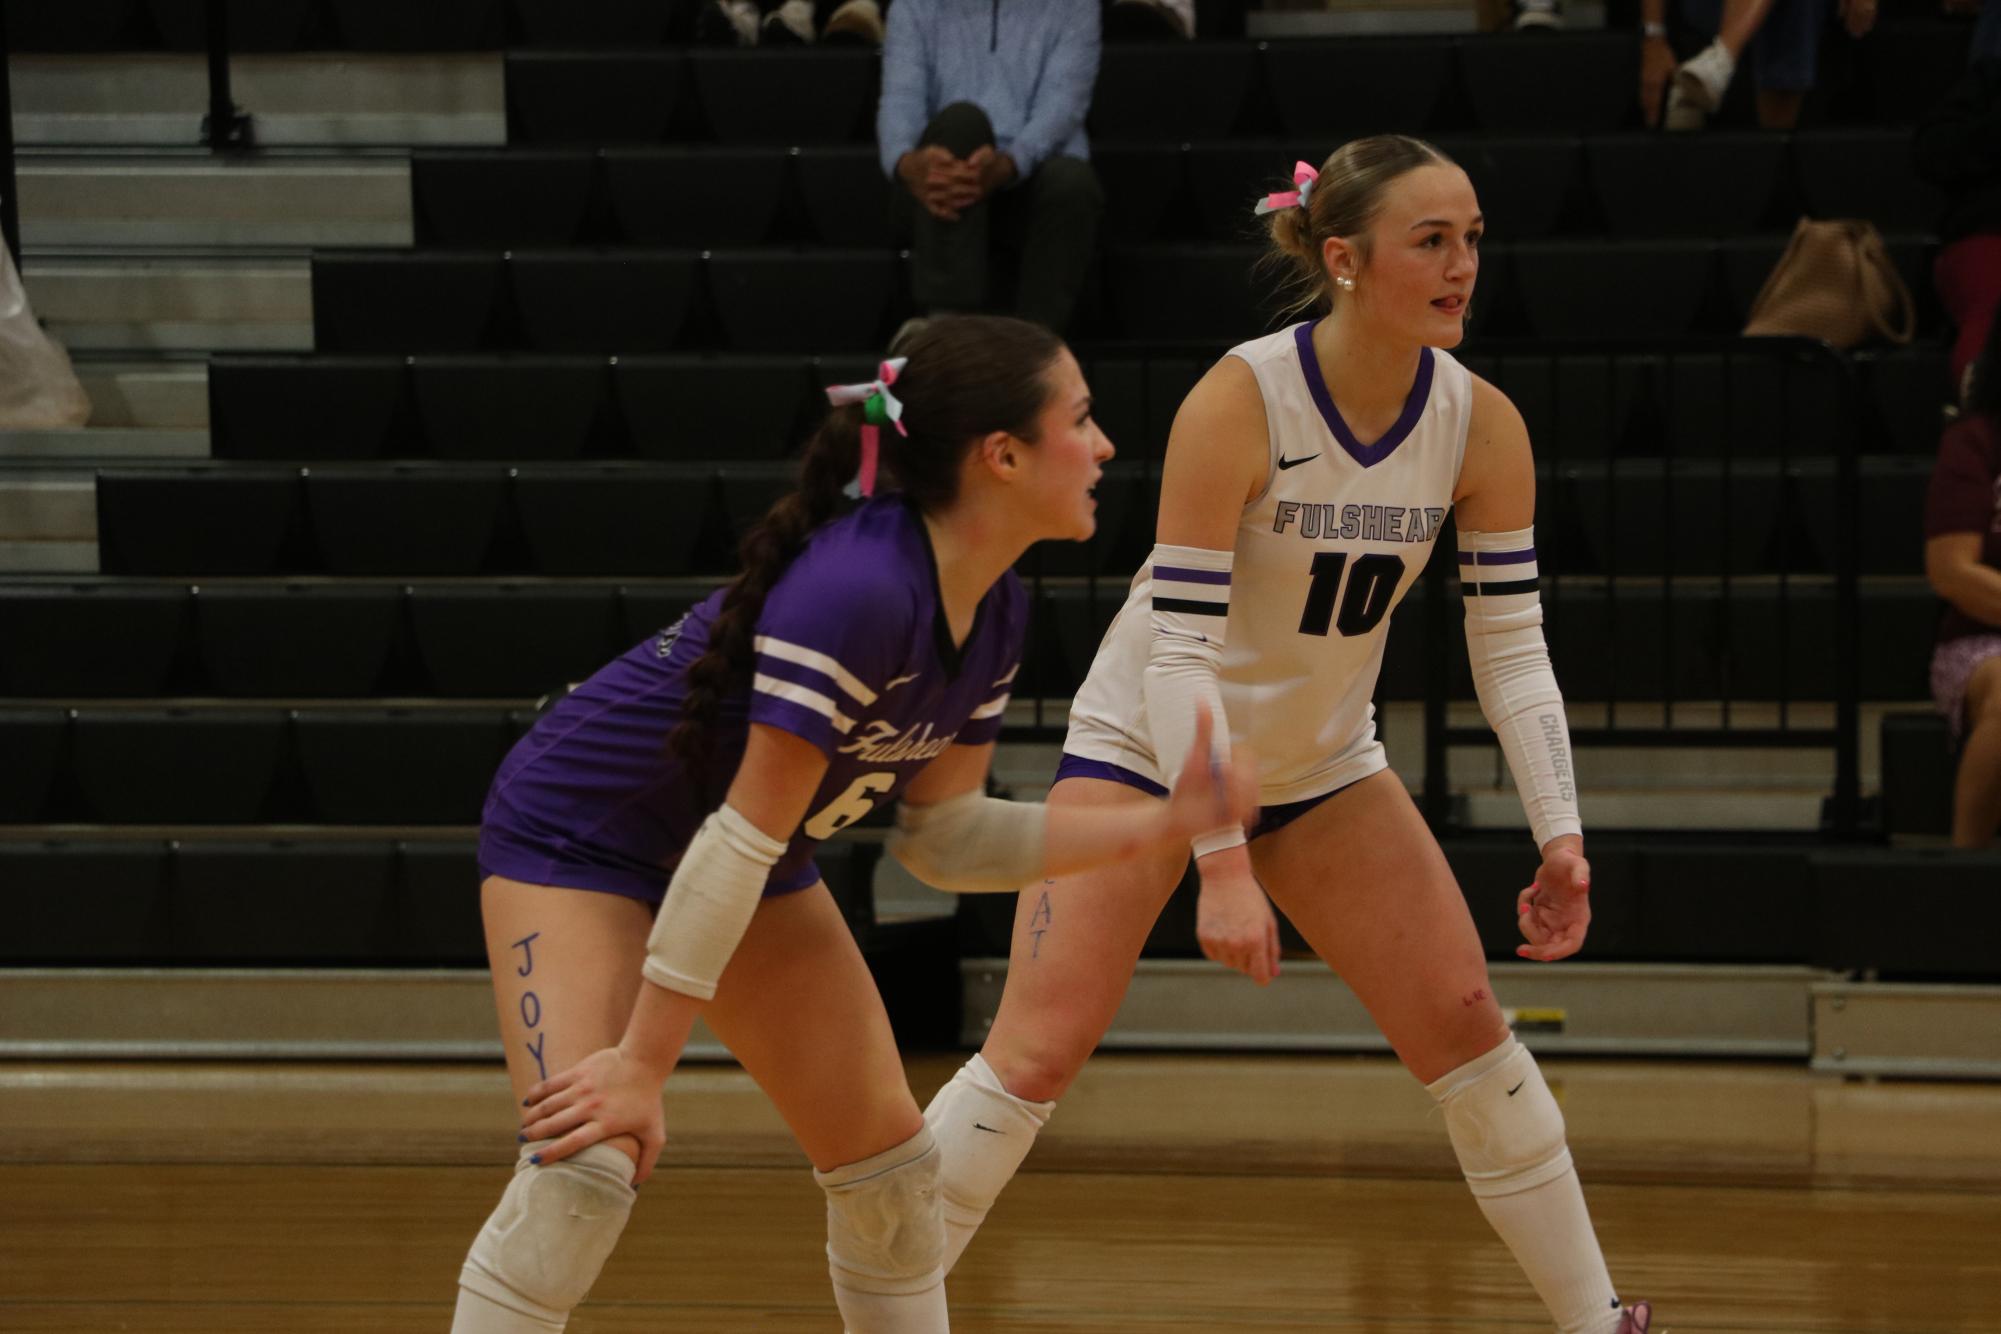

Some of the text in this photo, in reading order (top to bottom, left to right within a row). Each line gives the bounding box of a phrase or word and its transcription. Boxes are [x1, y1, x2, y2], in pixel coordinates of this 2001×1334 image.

[1273, 501, 1446, 542] FULSHEAR
[1298, 552, 1406, 637] 10
[1539, 713, 1575, 802] CHARGERS
[804, 772, 896, 840] 6
[1029, 879, 1056, 959] AT
[511, 931, 546, 1080] JOY
